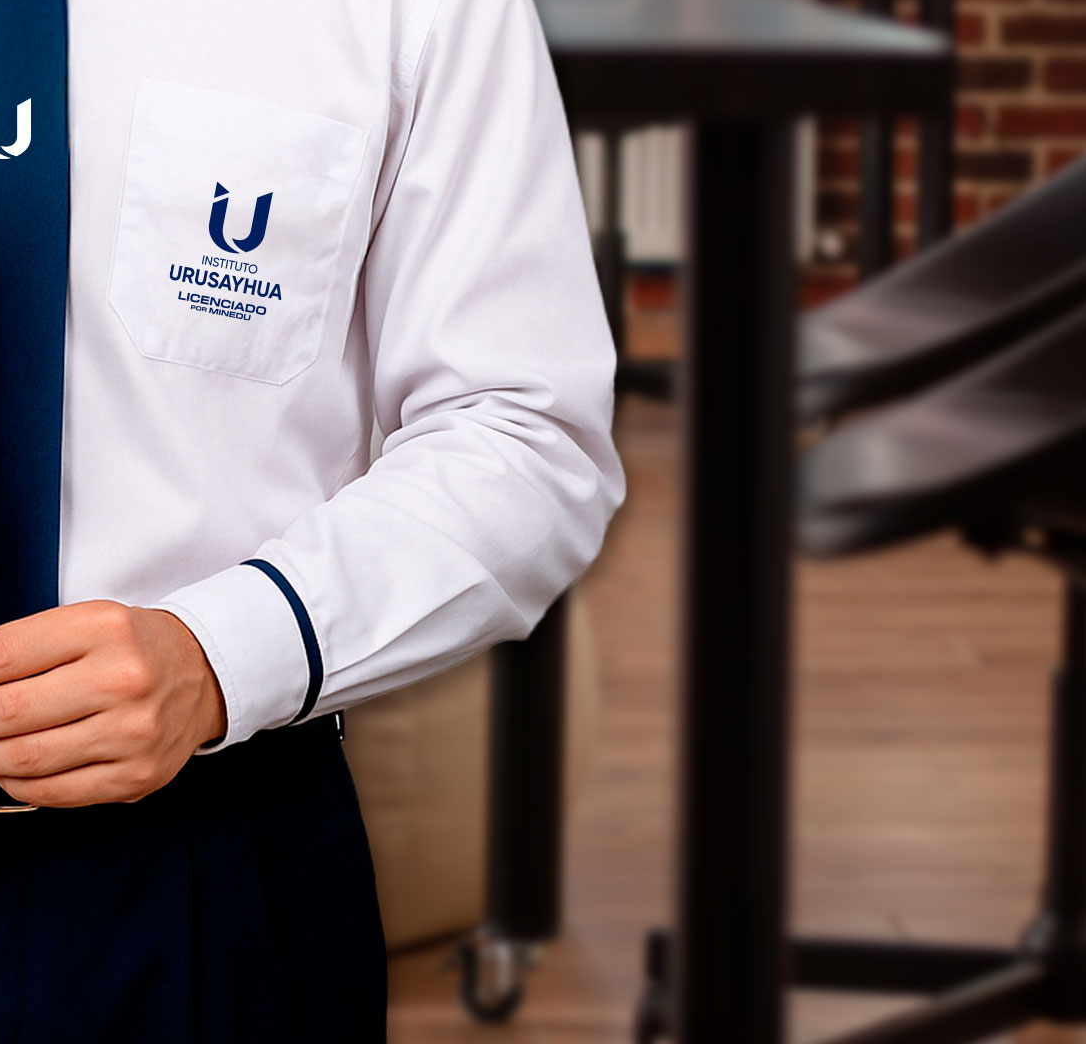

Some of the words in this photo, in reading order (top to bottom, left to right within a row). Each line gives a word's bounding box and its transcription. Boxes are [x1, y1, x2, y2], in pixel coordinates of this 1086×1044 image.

[201, 255, 258, 274] INSTITUTO
[169, 264, 282, 300] URUSAYHUA
[178, 291, 267, 315] LICENCIADO
[190, 304, 207, 313] POR
[208, 307, 252, 321] MINEDU
